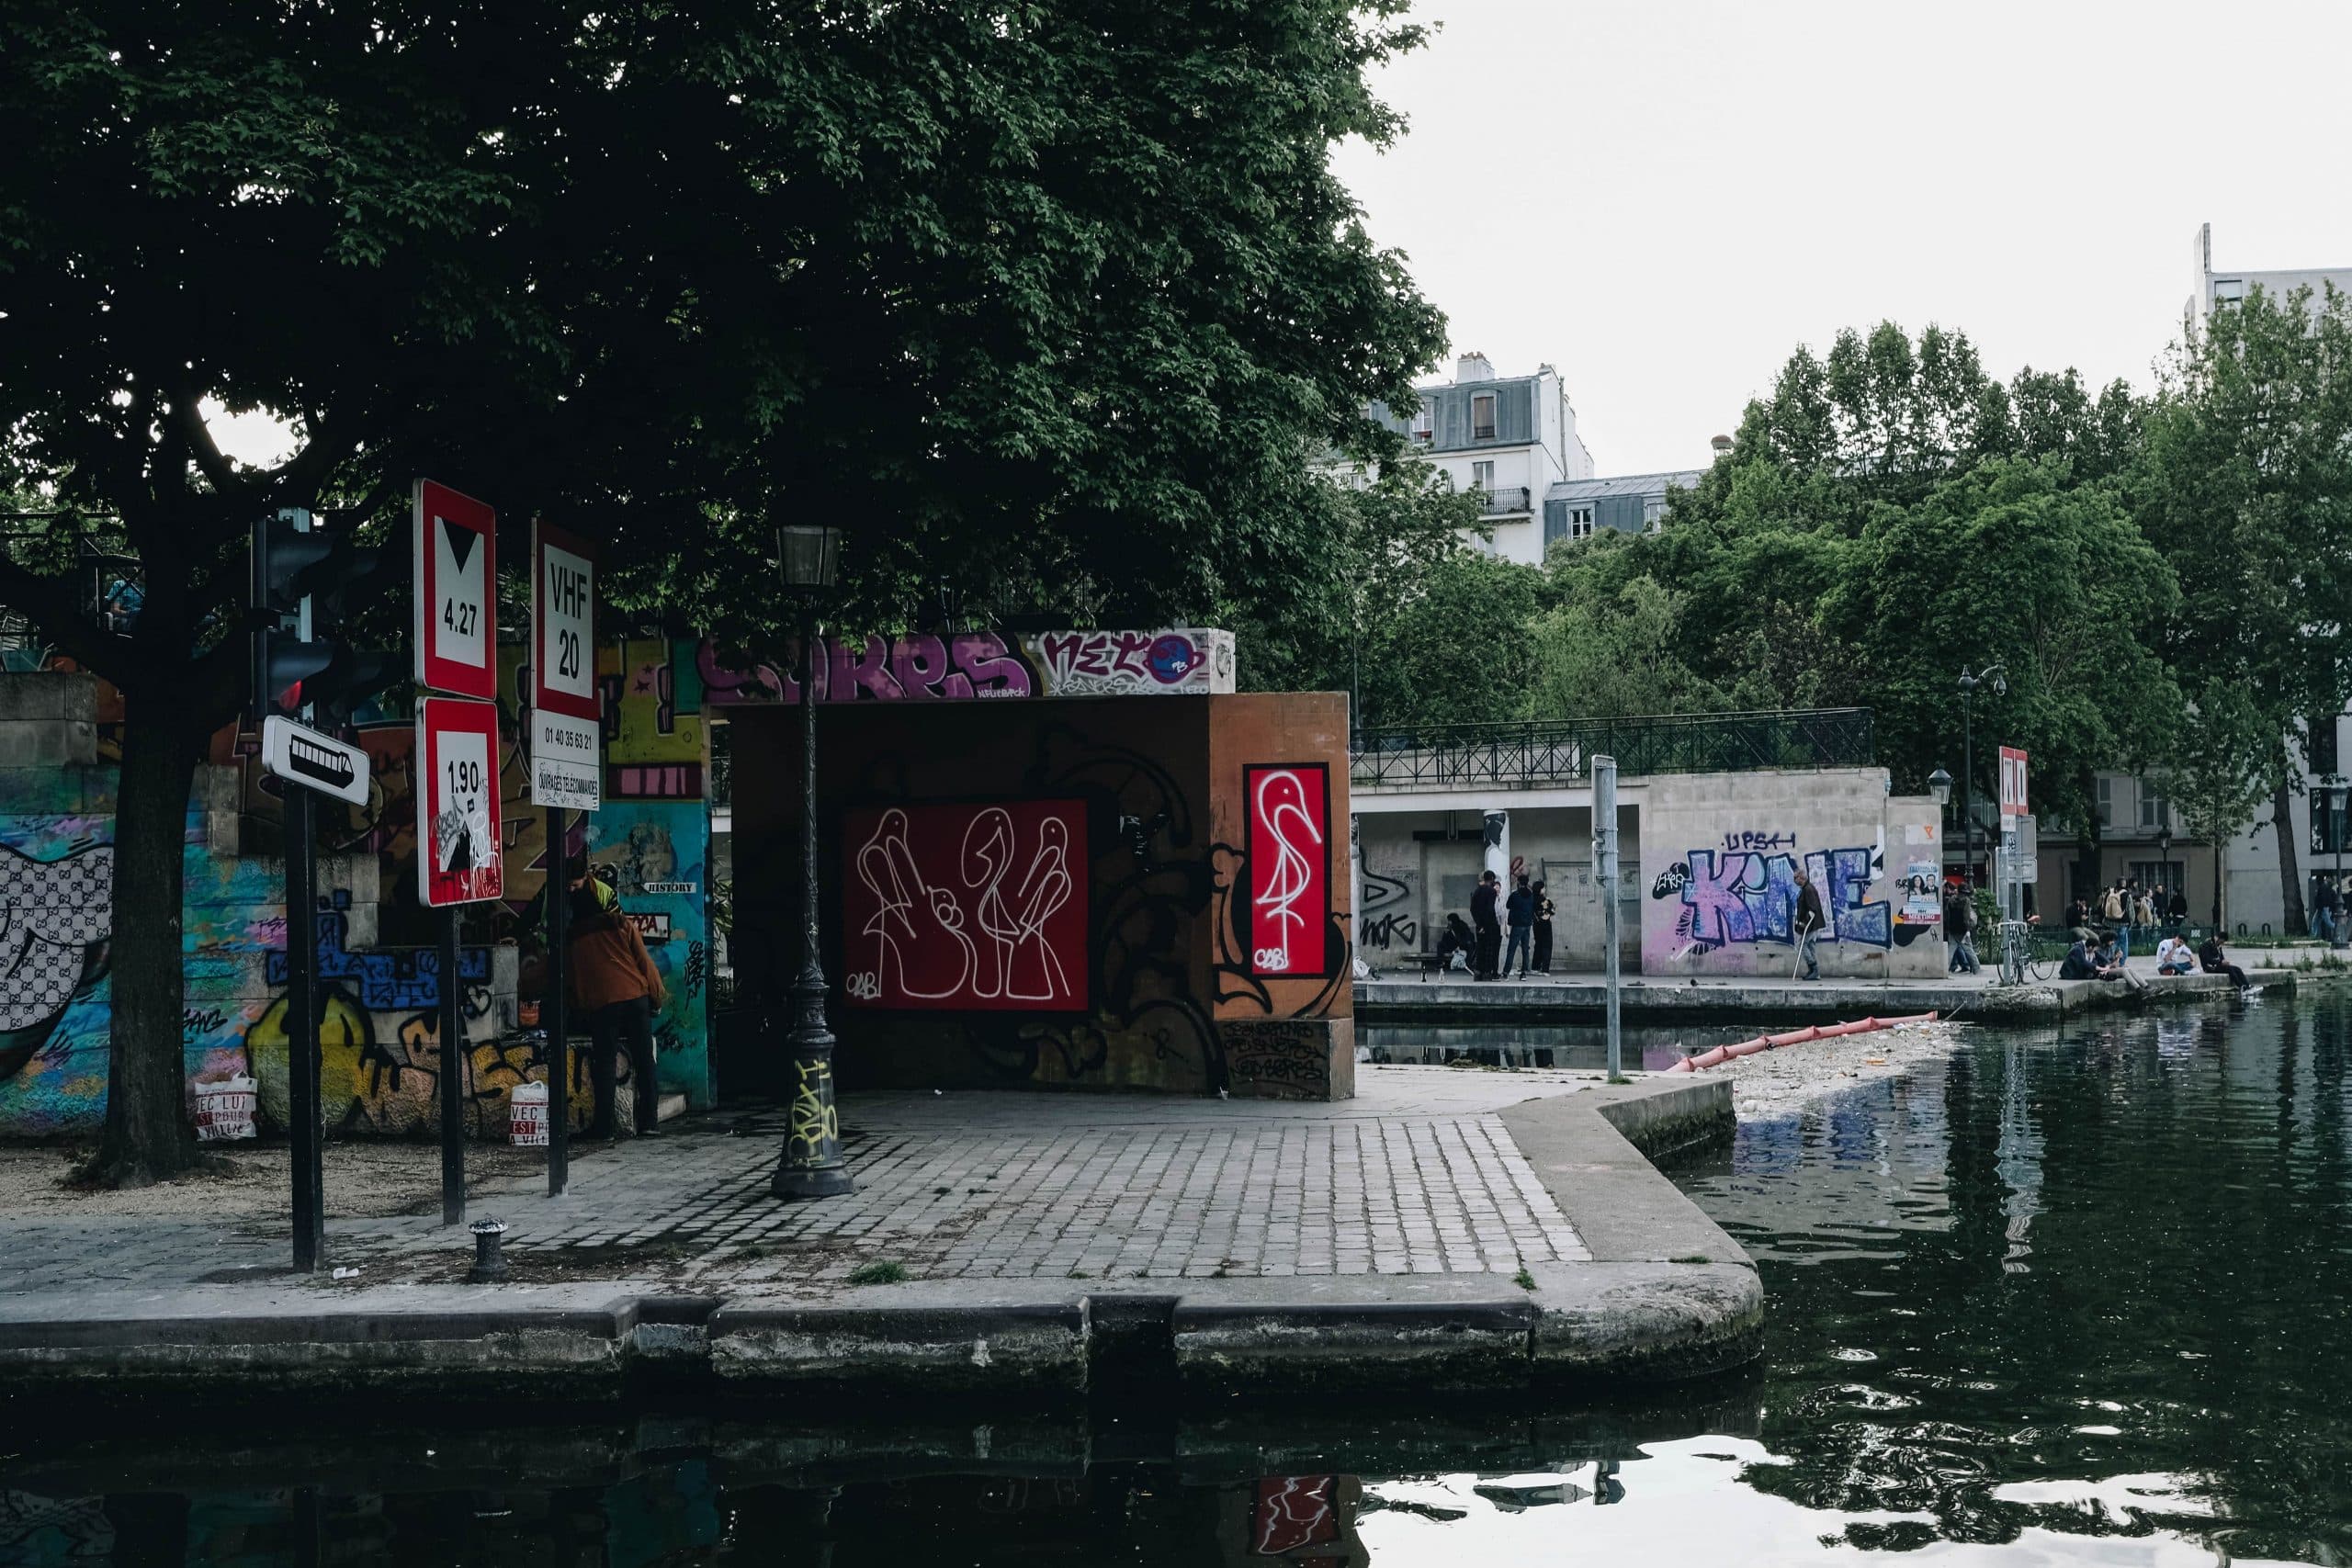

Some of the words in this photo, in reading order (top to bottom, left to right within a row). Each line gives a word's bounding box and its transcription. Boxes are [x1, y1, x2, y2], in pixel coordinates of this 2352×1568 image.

[550, 563, 587, 620] VHF
[444, 597, 478, 637] 4.27
[559, 629, 579, 679] 20
[545, 727, 553, 744] 01
[556, 728, 564, 745] 40
[566, 730, 573, 747] 35
[575, 733, 582, 749] 63
[584, 734, 592, 750] 21
[447, 761, 479, 794] 1.90
[538, 773, 562, 792] OUVRAGES
[563, 773, 598, 796] TÉLÉCOMMANDÉS
[648, 883, 693, 893] HISTORY
[215, 1111, 244, 1122] POUR
[511, 1106, 537, 1120] VEC
[513, 1122, 535, 1134] EST
